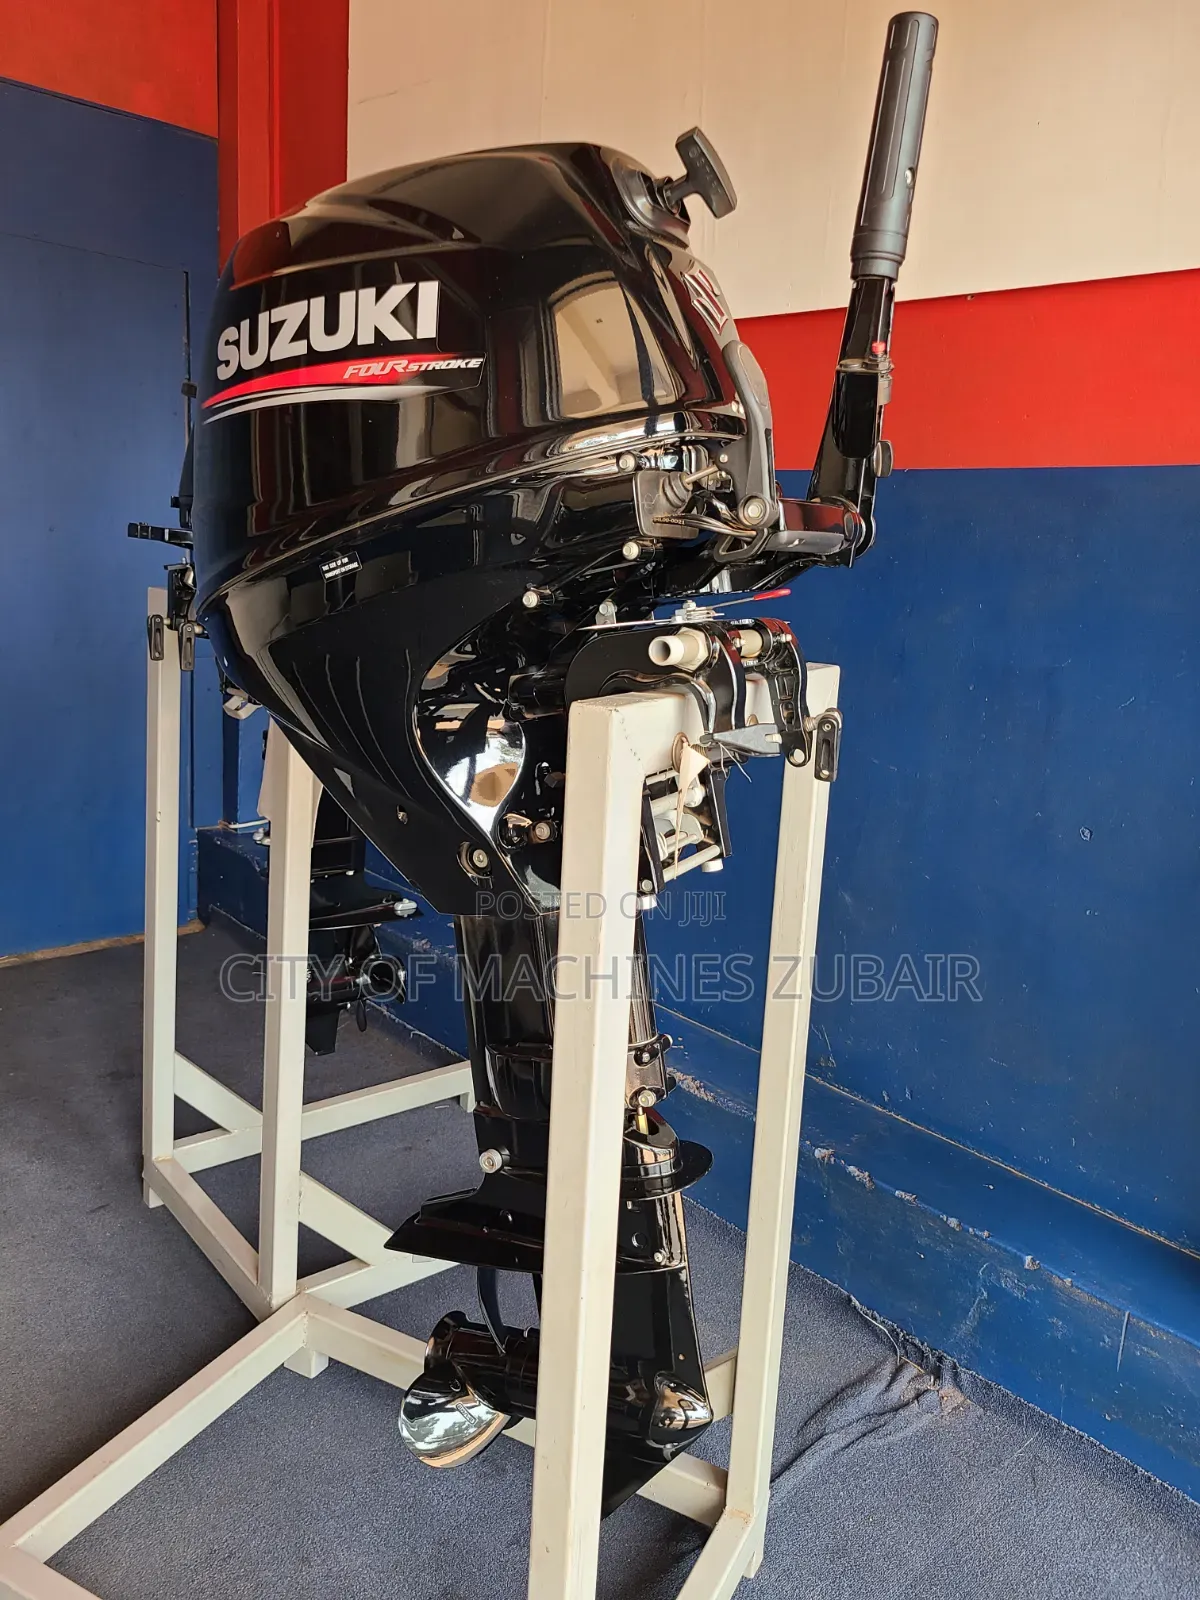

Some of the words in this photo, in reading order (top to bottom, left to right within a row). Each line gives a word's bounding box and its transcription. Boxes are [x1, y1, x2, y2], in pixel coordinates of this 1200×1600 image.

[216, 280, 440, 381] SUZUKI
[343, 359, 408, 379] FOUR
[406, 358, 484, 372] STROKE
